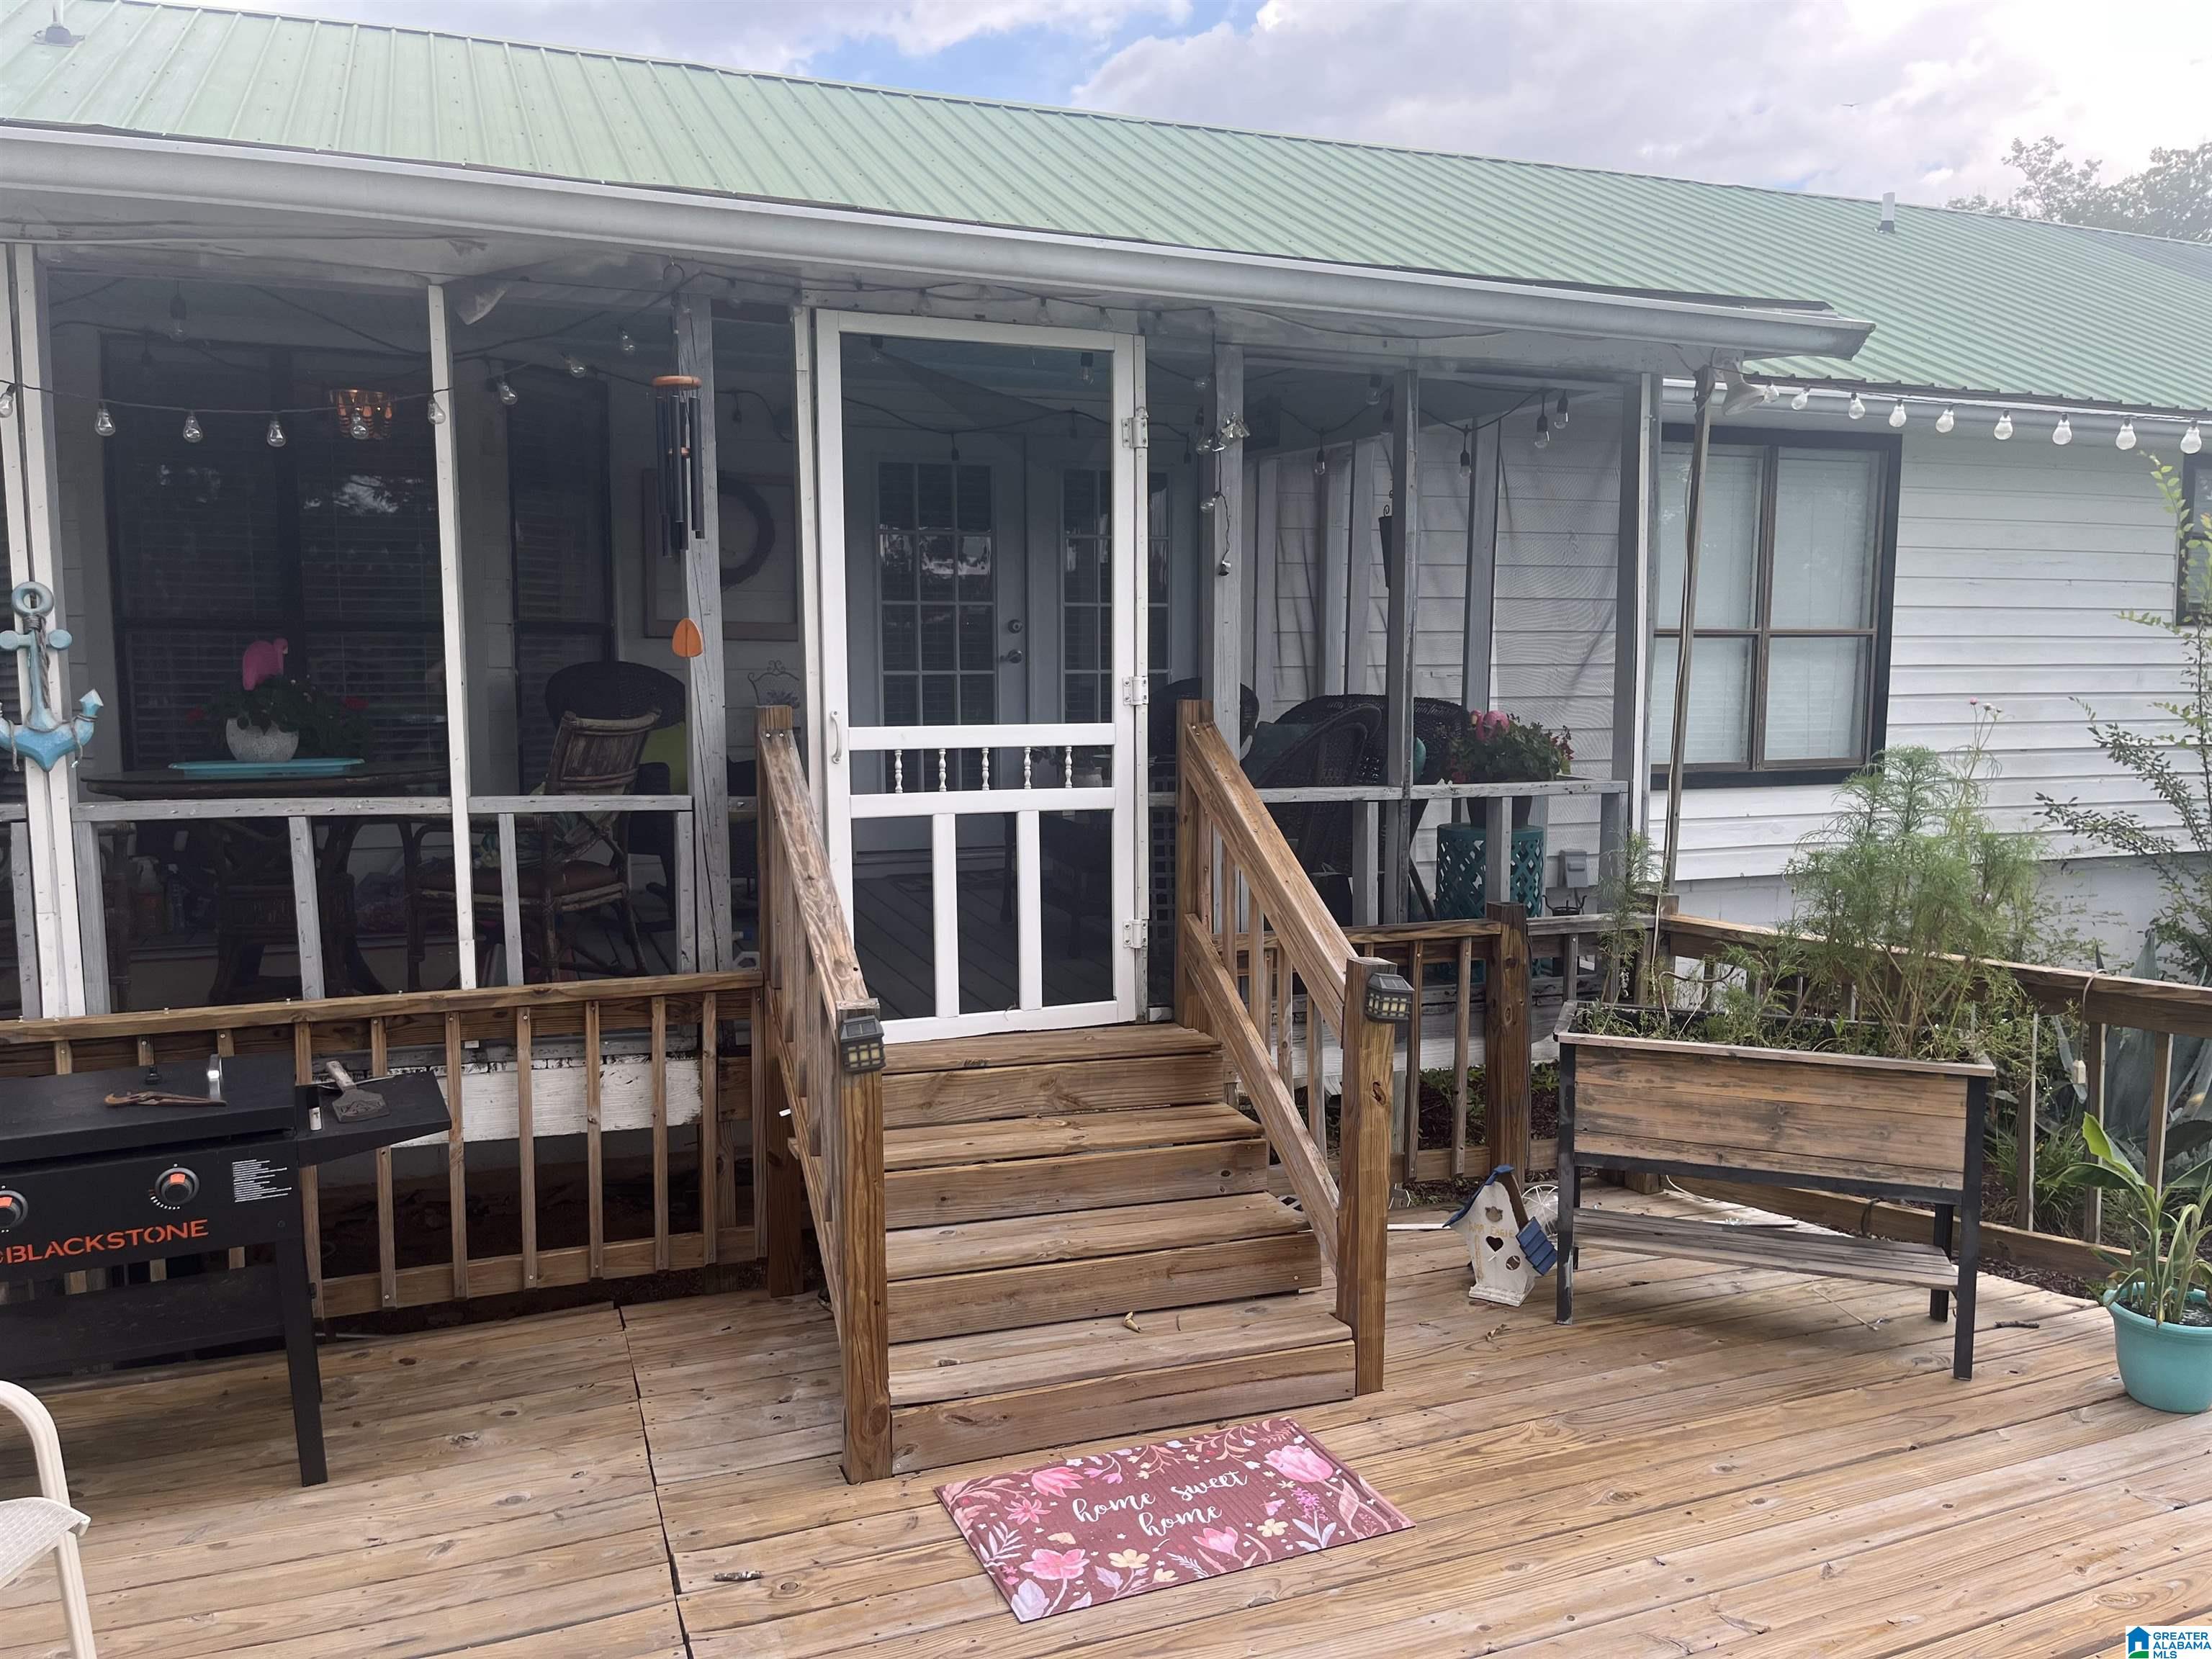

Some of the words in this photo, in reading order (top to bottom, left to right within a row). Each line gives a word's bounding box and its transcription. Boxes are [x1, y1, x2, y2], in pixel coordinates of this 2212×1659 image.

[6, 1218, 209, 1264] BLACKSTONE
[1072, 1492, 1156, 1522] home
[1170, 1470, 1248, 1501] sweet
[1138, 1505, 1223, 1537] home
